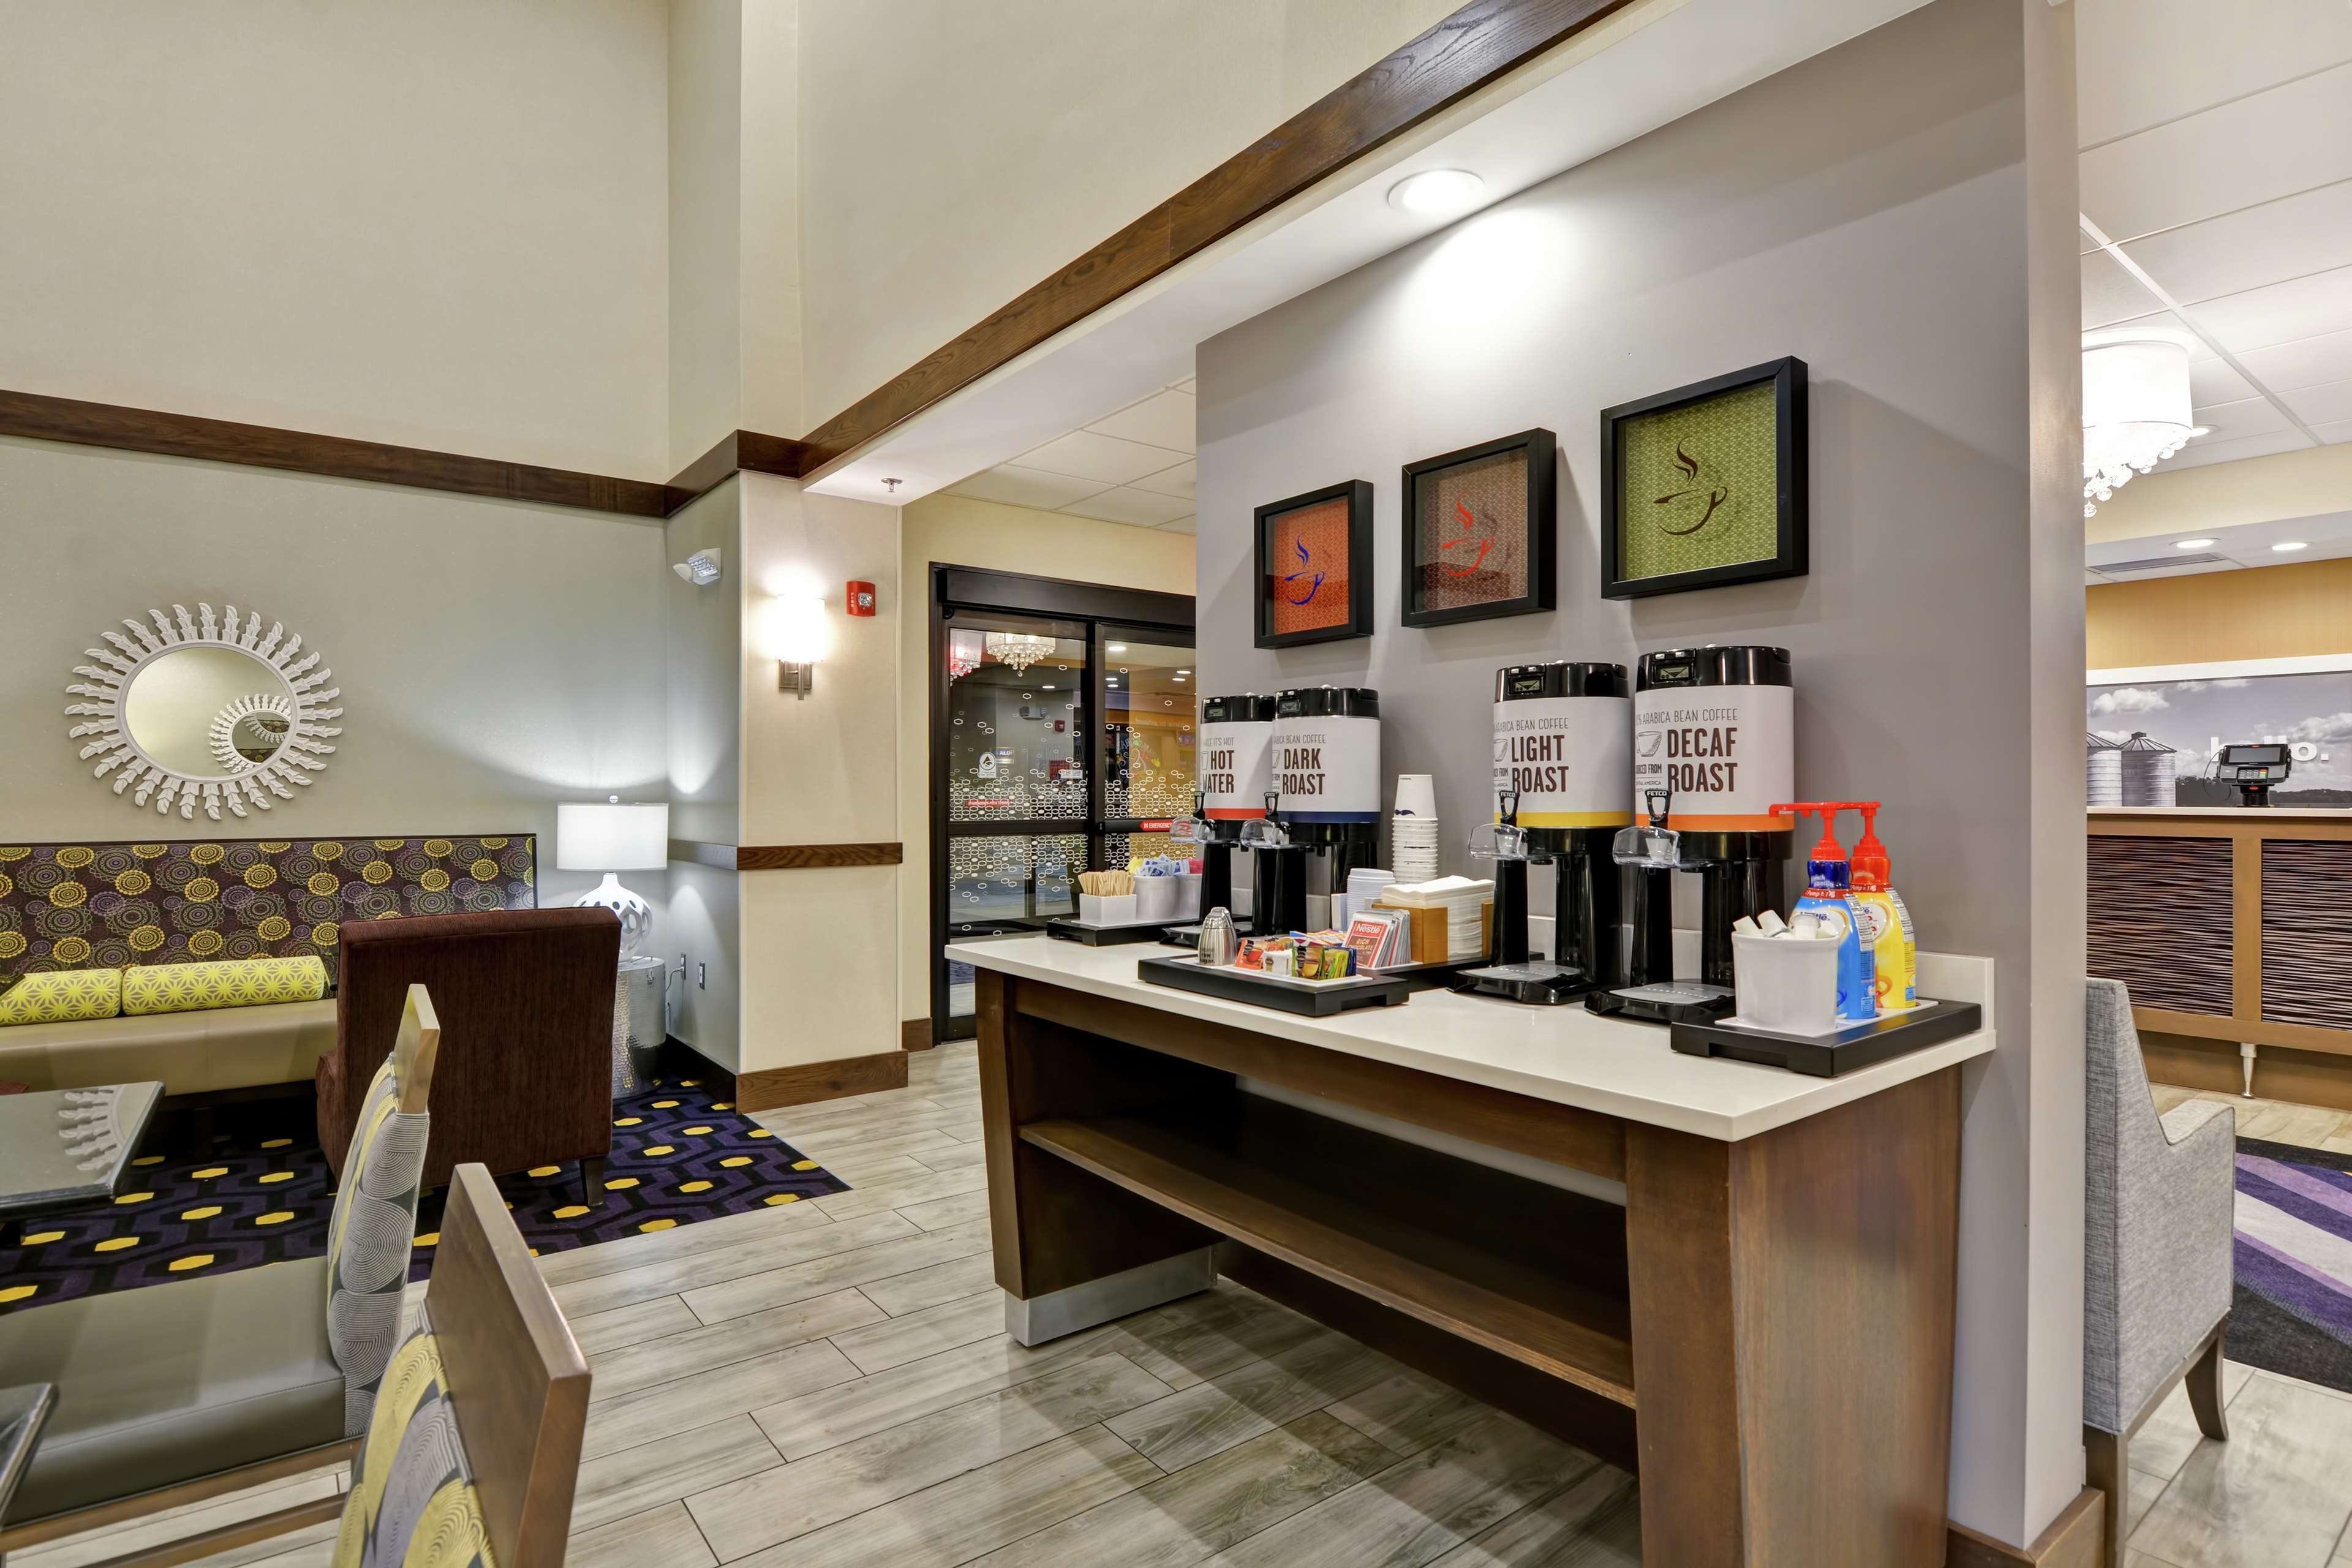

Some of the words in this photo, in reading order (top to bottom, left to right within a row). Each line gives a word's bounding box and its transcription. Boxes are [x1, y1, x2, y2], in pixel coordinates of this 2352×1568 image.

[1516, 719, 1536, 731] BEAN
[1538, 717, 1569, 730] COFFEE
[1643, 711, 1671, 725] ARABICA
[1674, 709, 1698, 723] BEAN
[1703, 708, 1738, 722] COFFEE
[1223, 737, 1234, 745] HOT
[1286, 734, 1300, 744] BEAN
[1302, 734, 1327, 744] COFFEE
[1511, 734, 1565, 763] LIGHT
[1667, 727, 1738, 758] DECAF
[1210, 750, 1235, 770] HOT
[1284, 748, 1322, 770] DARK
[1648, 763, 1662, 774] FROM
[1282, 774, 1325, 795] ROAST
[1512, 766, 1569, 793] ROAST
[1667, 763, 1738, 793] ROAST
